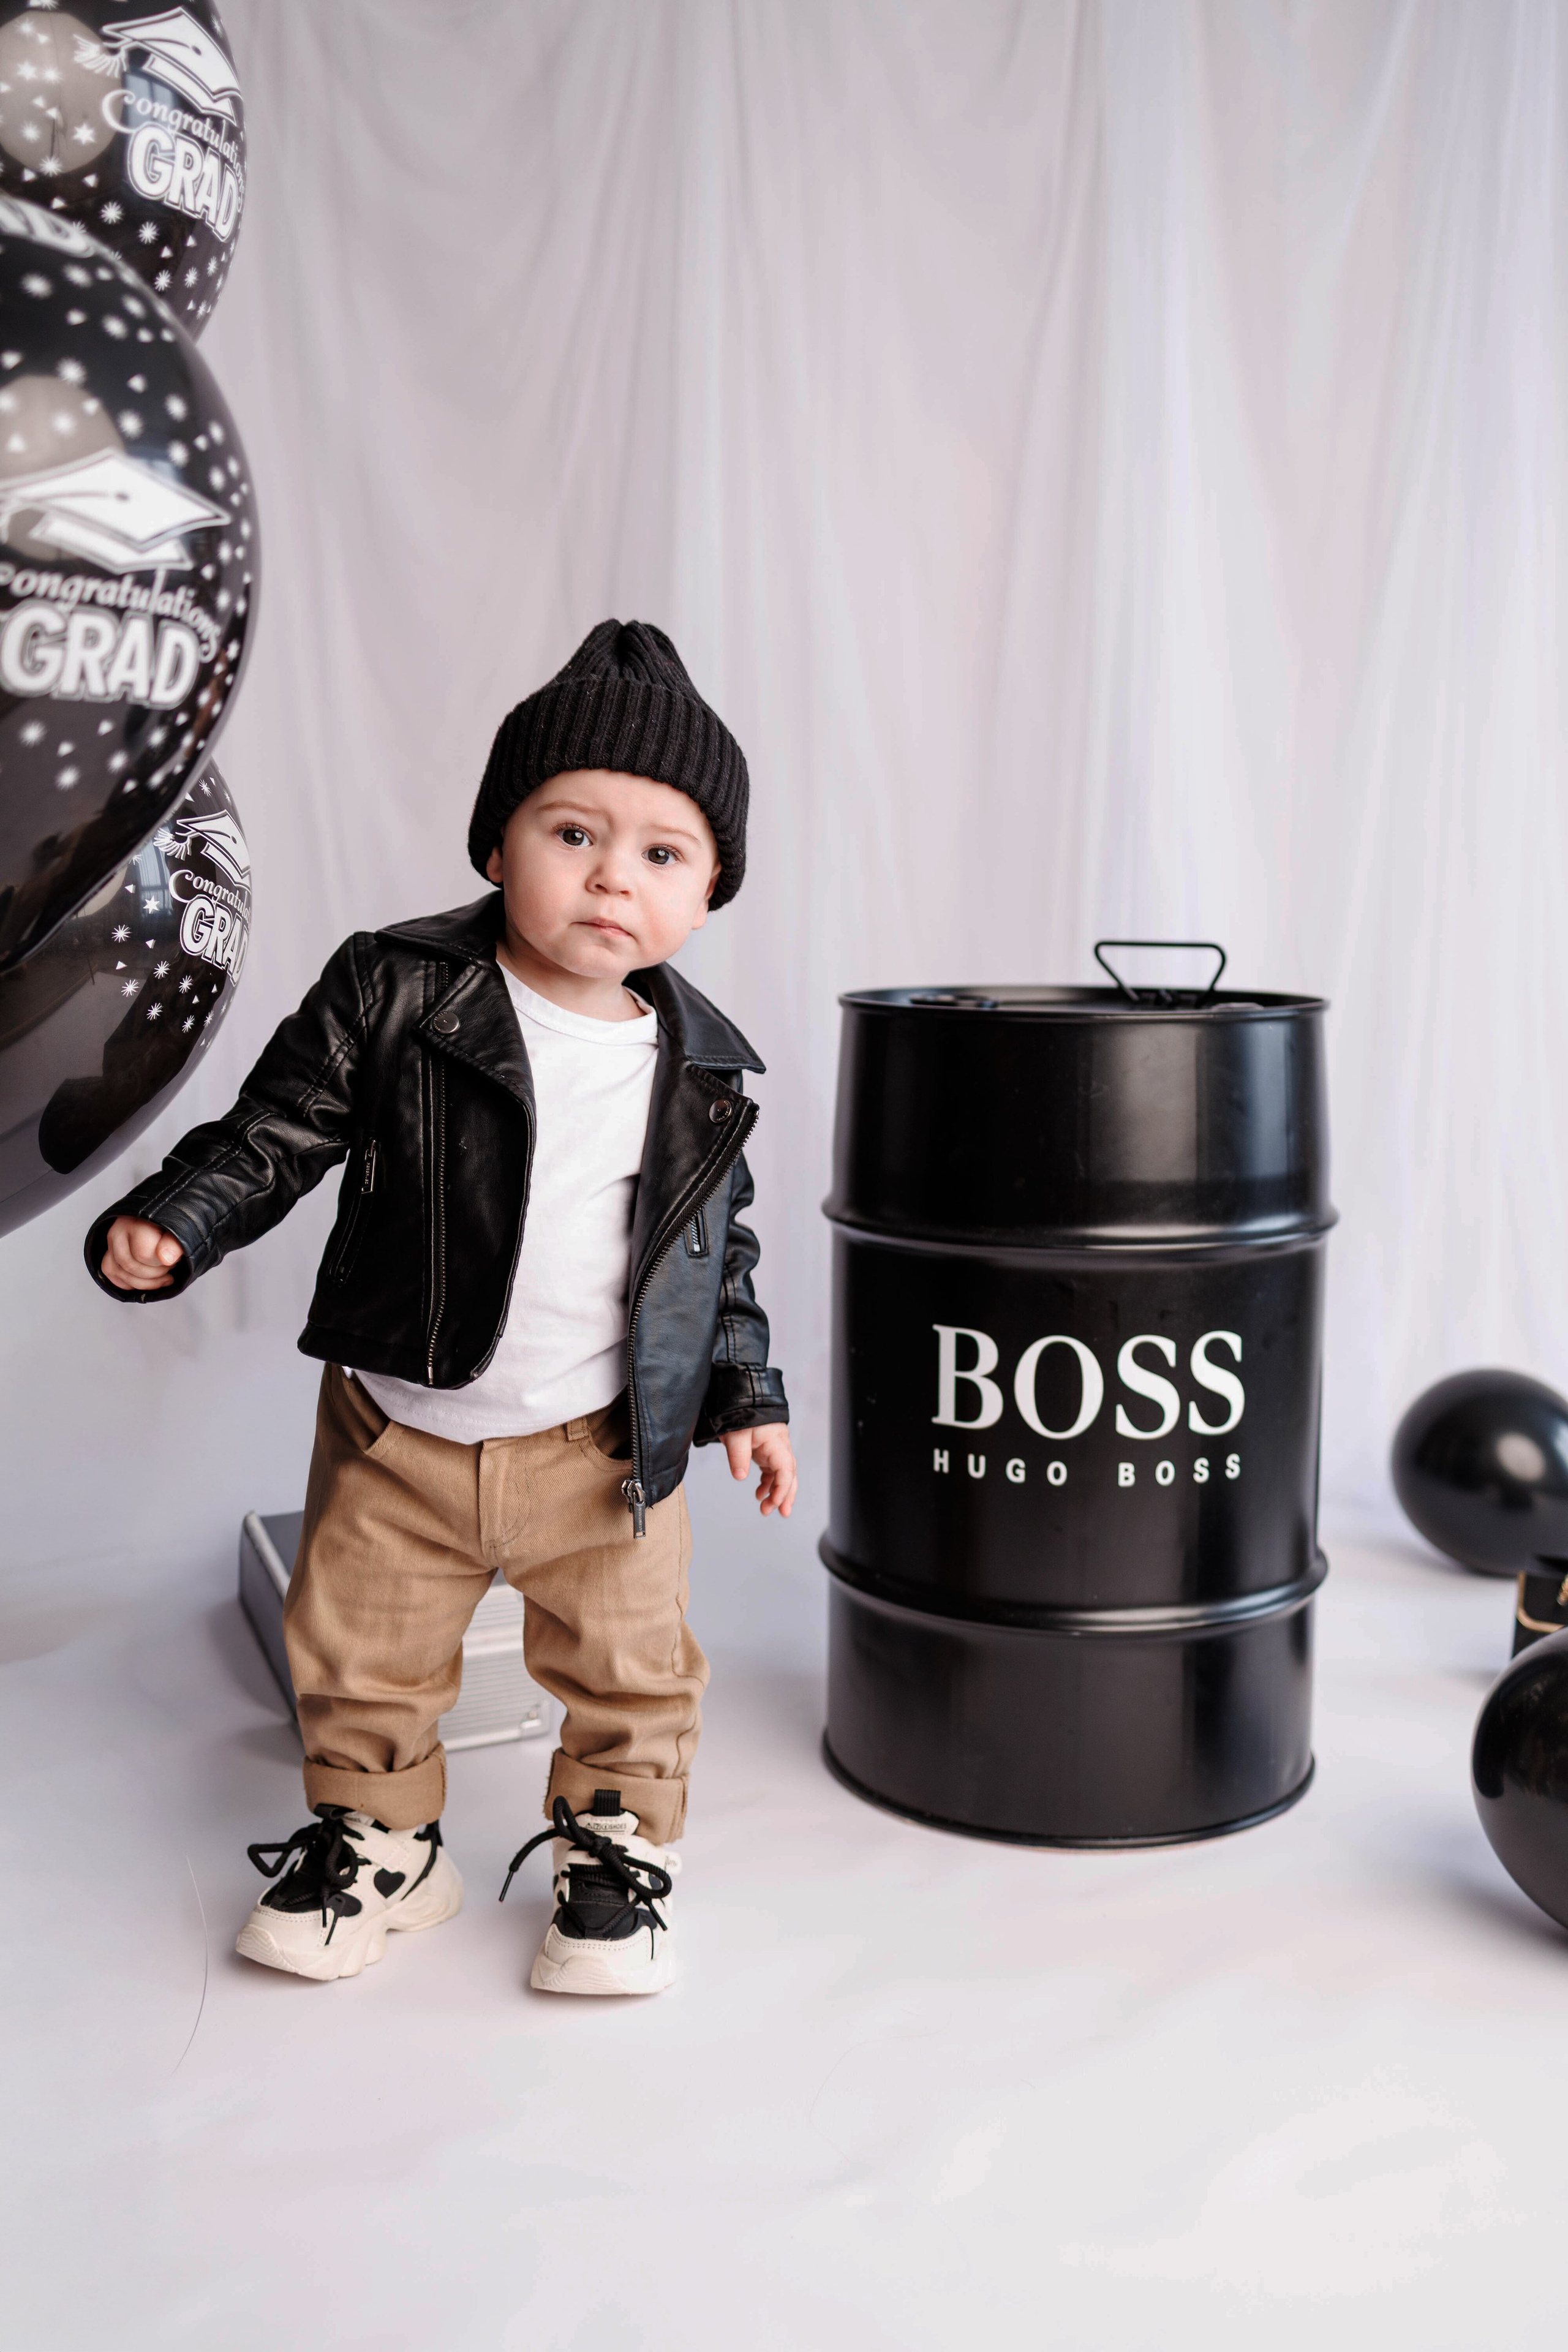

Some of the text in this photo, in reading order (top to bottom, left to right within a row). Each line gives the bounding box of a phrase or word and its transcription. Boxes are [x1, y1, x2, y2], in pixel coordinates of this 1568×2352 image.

[127, 123, 240, 242] GRAD
[0, 598, 200, 710] GRAD
[932, 1324, 1245, 1440] BOSS
[933, 1448, 1241, 1487] HUGO BOSS
